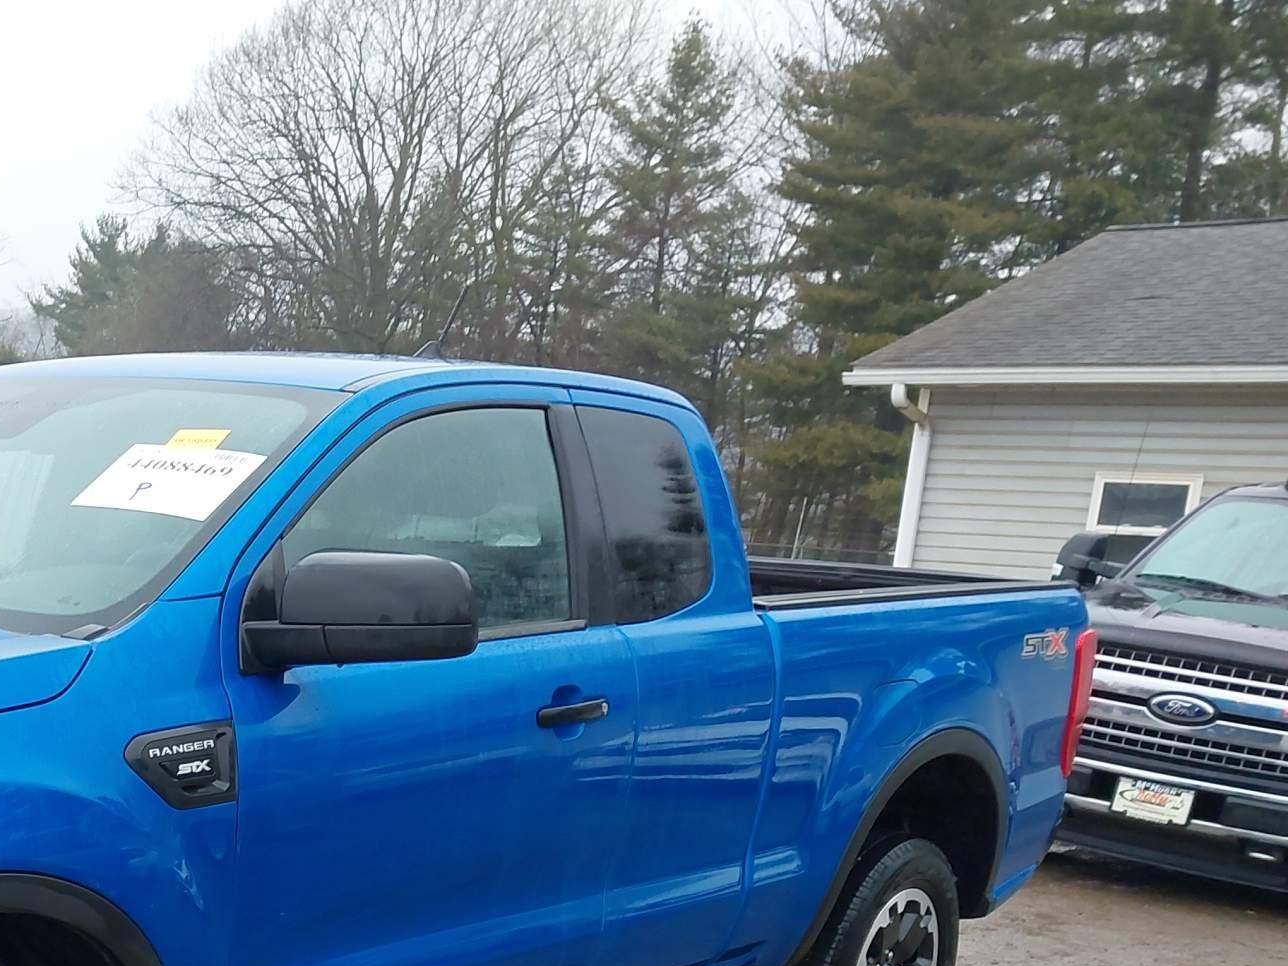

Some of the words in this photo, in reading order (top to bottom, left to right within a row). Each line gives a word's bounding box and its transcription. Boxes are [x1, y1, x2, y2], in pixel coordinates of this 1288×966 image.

[128, 458, 234, 476] 44088469
[1022, 627, 1069, 660] STX
[1163, 700, 1200, 717] Ford
[149, 739, 215, 758] RANGER
[176, 759, 213, 776] STX
